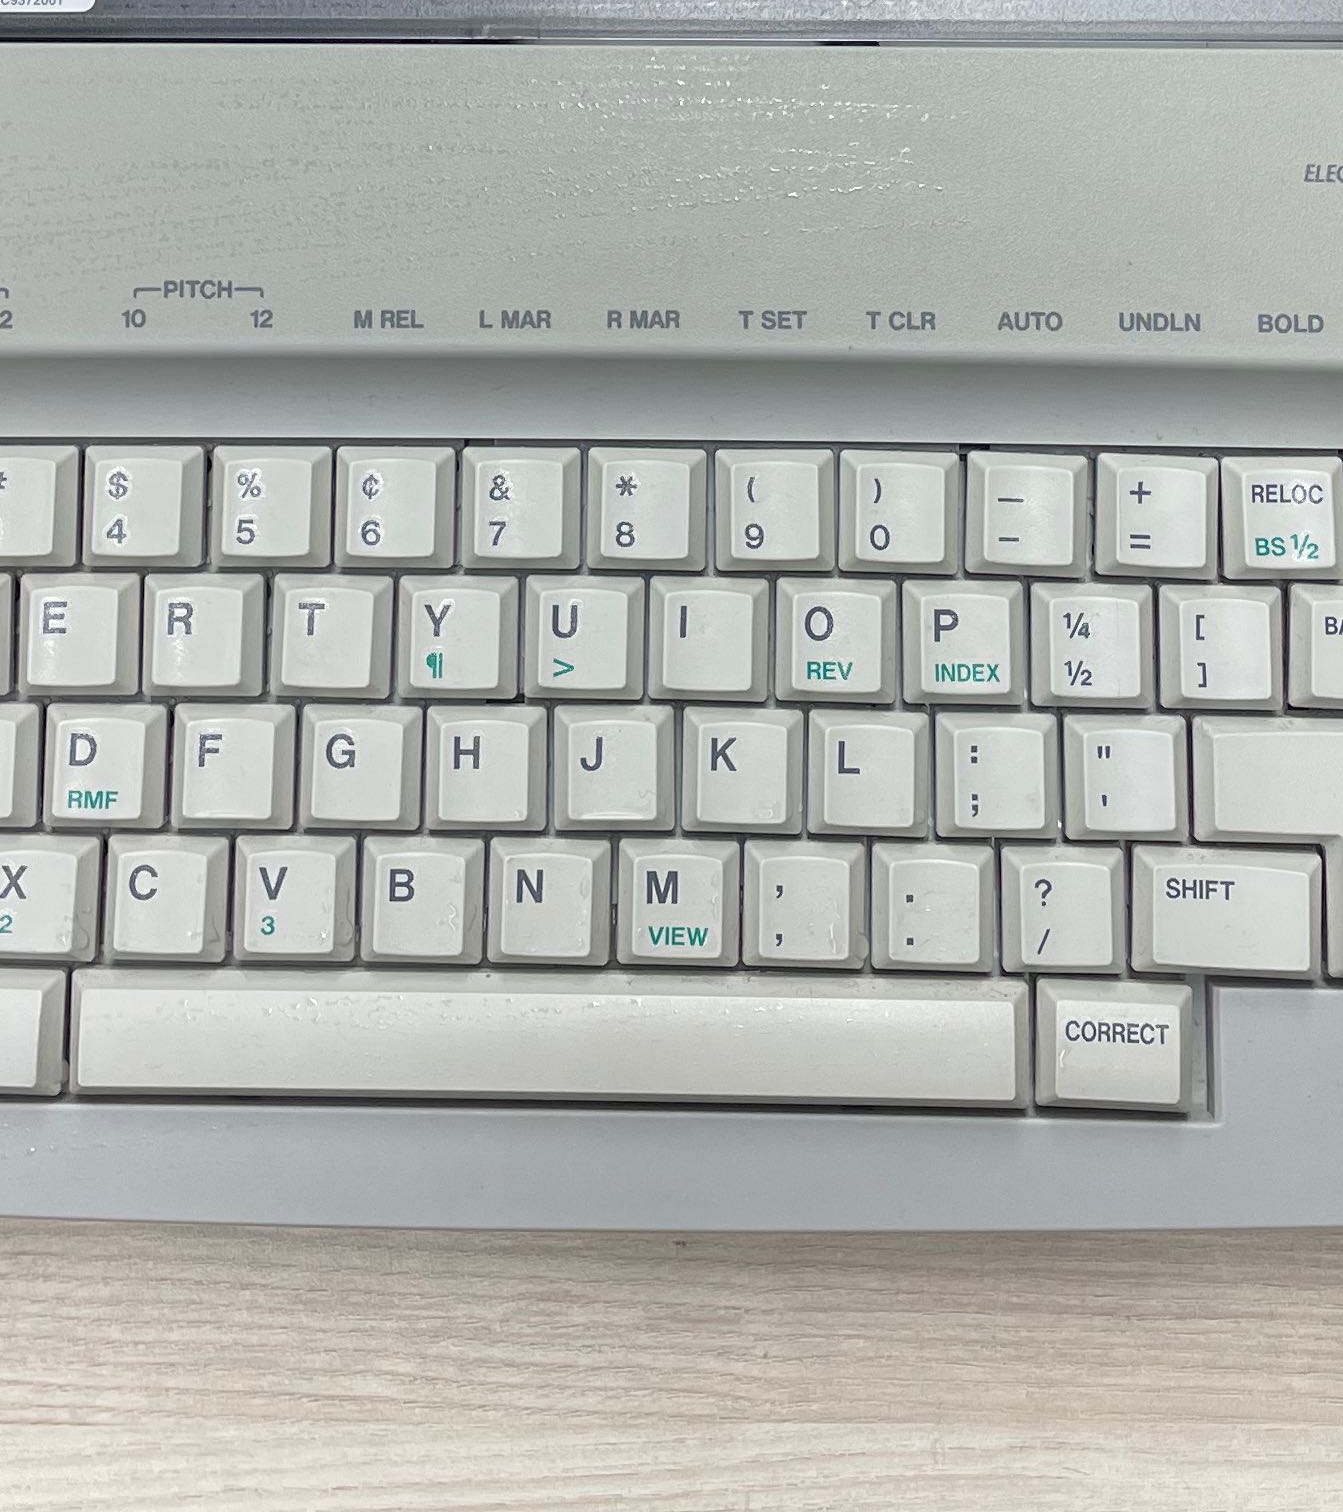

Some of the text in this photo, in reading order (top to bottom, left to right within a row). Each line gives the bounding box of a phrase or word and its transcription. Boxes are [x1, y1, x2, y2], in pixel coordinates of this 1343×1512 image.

[163, 279, 233, 300] PITCH
[0, 309, 13, 329] 2
[121, 308, 147, 329] 10
[250, 309, 274, 329] 12
[353, 309, 425, 329] M REL
[479, 309, 552, 330] L MAR
[606, 309, 681, 329] R MAR
[738, 309, 808, 330] T SET
[865, 310, 936, 331] T CLR
[997, 311, 1063, 332] AUTO
[1118, 312, 1201, 332] UNDLN
[1257, 313, 1324, 334] BOLD
[1251, 484, 1323, 505] RELOC
[106, 518, 127, 544] 4
[236, 519, 256, 545] 5
[361, 520, 381, 546] 6
[488, 521, 507, 546] 7
[615, 521, 636, 548] 8
[744, 523, 765, 550] 9
[869, 524, 891, 551] 0
[1254, 536, 1287, 557] BS
[42, 601, 68, 635] E
[167, 601, 194, 636] R
[298, 602, 326, 637] T
[424, 604, 452, 638] Y
[551, 604, 578, 639] U
[804, 605, 834, 642] O
[933, 608, 959, 643] P
[806, 661, 853, 681] REV
[934, 663, 1000, 683] INDEX
[68, 732, 98, 767] D
[198, 733, 223, 768] F
[325, 733, 356, 770] G
[453, 735, 481, 770] H
[580, 736, 603, 772] J
[710, 737, 737, 772] K
[837, 740, 861, 775] L
[67, 790, 119, 810] RMF
[128, 864, 159, 901] C
[258, 866, 288, 901] V
[388, 868, 415, 902] B
[516, 869, 544, 904] N
[646, 870, 679, 905] M
[1165, 877, 1235, 901] SHIFT
[260, 915, 275, 936] 3
[648, 926, 709, 947] VIEW
[1065, 1020, 1170, 1045] CORRECT
